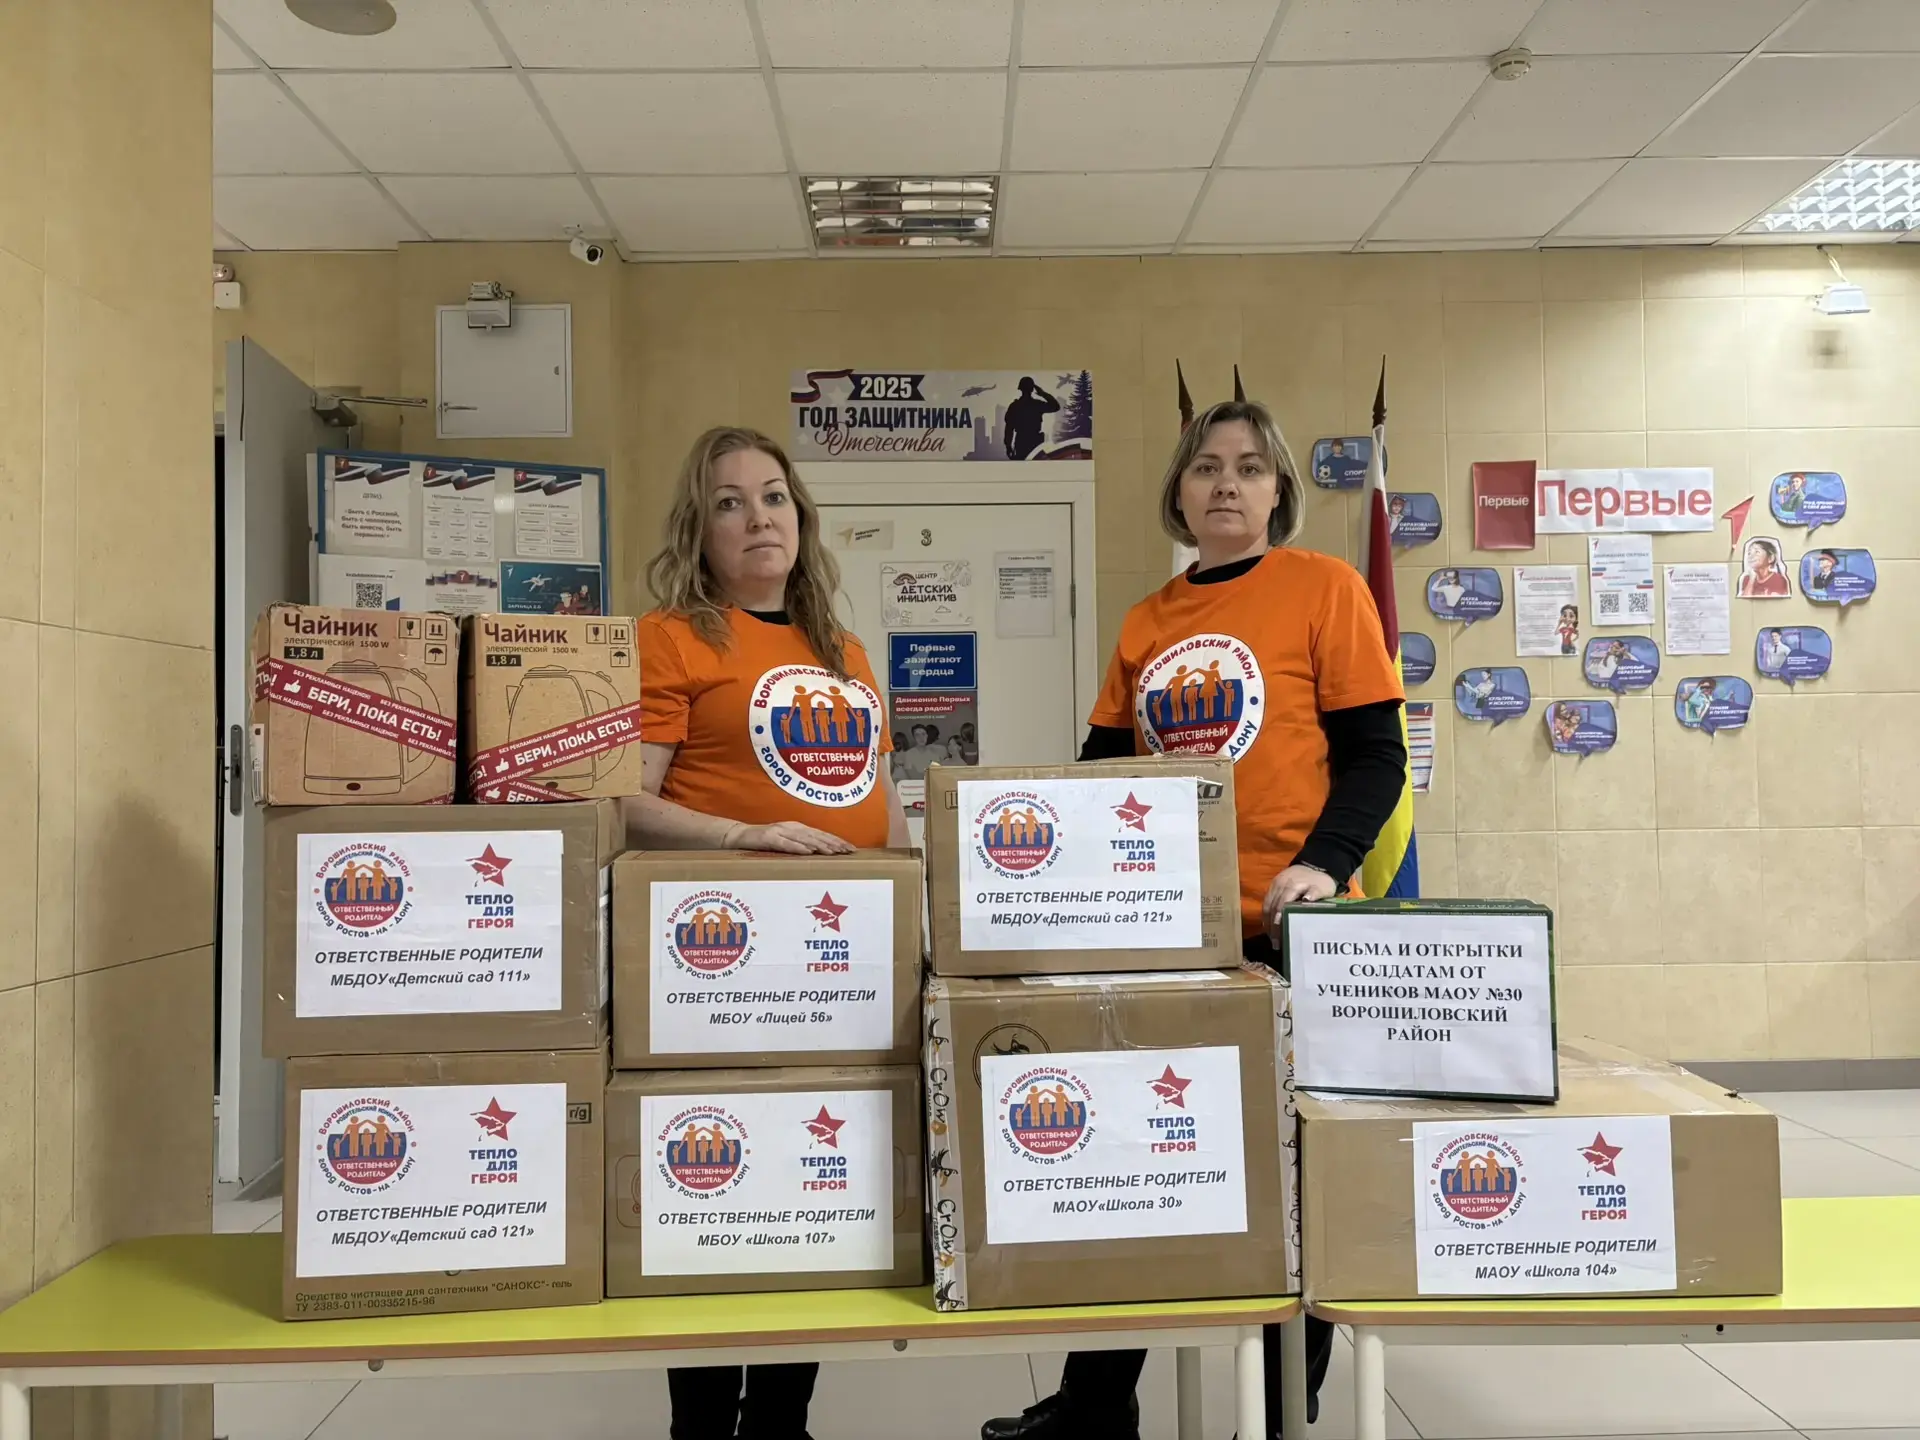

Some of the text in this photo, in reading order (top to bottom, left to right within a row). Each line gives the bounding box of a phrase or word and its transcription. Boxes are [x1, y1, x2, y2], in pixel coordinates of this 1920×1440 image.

[860, 376, 913, 399] 2025
[799, 406, 973, 432] ГОД ЗАЩИТНИКА
[815, 422, 946, 456] Отечества
[1479, 495, 1530, 510] Первые
[1538, 480, 1712, 528] Первые
[921, 529, 932, 546] 3
[901, 585, 953, 595] ДЕТСКИХ
[897, 594, 957, 604] ИНИЦИАТИВ
[284, 614, 378, 638] Чайник
[485, 624, 568, 644] Чайник
[284, 637, 355, 648] электрический
[910, 644, 956, 653] Первые
[290, 648, 318, 658] 1,8 л
[486, 645, 548, 654] электрический
[491, 656, 507, 666] 1,8
[904, 656, 962, 665] зажигают
[1232, 647, 1256, 680] РАЙОН
[912, 668, 954, 677] сердца
[850, 680, 879, 709] АЙОН
[895, 696, 938, 704] Движение
[308, 687, 442, 741] БЕРИ, ПОКА ЕСТЬ!
[896, 705, 953, 714] всегда рядом!
[1164, 725, 1228, 743] ОТВЕТСТВЕННЫЙ
[515, 717, 633, 766] БЕРИ, ПОКА ЕСТЬ!
[790, 750, 865, 763] ОТВЕТСТВЕННЫЙ
[807, 766, 855, 776] РОДИТЕЛЬ
[1040, 798, 1060, 824] РАЙОН
[1110, 840, 1155, 850] ТЕПЛО
[1127, 851, 1155, 861] ДЛЯ
[389, 852, 412, 878] РАЙОН
[1113, 863, 1156, 872] ГЕРОЯ
[466, 894, 514, 905] ТЕПЛО
[976, 890, 1184, 904] ОТВЕТСТВЕННЫЕ РОДИТЕЛИ
[483, 906, 514, 917] ДЛЯ
[736, 898, 756, 924] РАЙОН
[468, 918, 514, 929] ГЕРОЯ
[1114, 913, 1139, 925] сад
[1143, 912, 1173, 923] 121»
[805, 940, 849, 950] ТЕПЛО
[1313, 942, 1523, 958] ПИСЬМА И ОТКРЫТКИ
[315, 948, 544, 964] ОТВЕТСТВЕННЫЕ РОДИТЕЛИ
[821, 951, 849, 961] ДЛЯ
[807, 963, 849, 972] ГЕРОЯ
[1349, 964, 1486, 980] СОЛДАТАМ ОТ
[468, 971, 494, 984] сад
[499, 971, 530, 982] 111»
[667, 990, 876, 1004] ОТВЕТСТВЕННЫЕ РОДИТЕЛИ
[1318, 984, 1523, 1002] УЧЕНИКОВ МАОУ №30
[710, 1012, 832, 1026] МБОУ «Лицей 56»
[1332, 1005, 1509, 1023] ВОРОШИЛОВСКИЙ
[1387, 1026, 1452, 1042] РАЙОН
[1147, 1117, 1195, 1128] ТЕПЛО
[1165, 1129, 1196, 1140] ДЛЯ
[1151, 1142, 1196, 1153] ГЕРОЯ
[469, 1149, 518, 1160] ТЕПЛО
[1502, 1142, 1524, 1168] РАЙОН
[486, 1161, 518, 1172] ДЛЯ
[800, 1156, 847, 1168] ТЕПЛО
[471, 1173, 518, 1184] ГЕРОЯ
[817, 1168, 847, 1179] ДЛЯ
[803, 1180, 847, 1191] ГЕРОЯ
[1004, 1171, 1227, 1193] ОТВЕТСТВЕННЫЕ РОДИТЕЛИ
[1578, 1185, 1626, 1196] ТЕПЛО
[1159, 1197, 1182, 1209] 30»
[1451, 1196, 1509, 1205] ОТВЕТСТВЕННЫЙ
[1596, 1198, 1627, 1208] ДЛЯ
[316, 1202, 547, 1222] ОТВЕТСТВЕННЫЕ РОДИТЕЛИ
[658, 1209, 876, 1225] ОТВЕТСТВЕННЫЕ РОДИТЕЛИ
[1582, 1210, 1627, 1221] ГЕРОЯ
[470, 1228, 498, 1241] сад
[502, 1225, 535, 1238] 121»
[698, 1232, 836, 1246] МБОУ «Школа 107»
[1434, 1240, 1657, 1257] ОТВЕТСТВЕННЫЕ РОДИТЕЛИ
[1475, 1264, 1617, 1279] МАОУ «Школа 104»
[296, 1292, 347, 1303] Средство
[350, 1288, 403, 1300] чистящее
[406, 1288, 425, 1297] для
[428, 1284, 488, 1296] сантехники
[296, 1303, 309, 1312] ТУ
